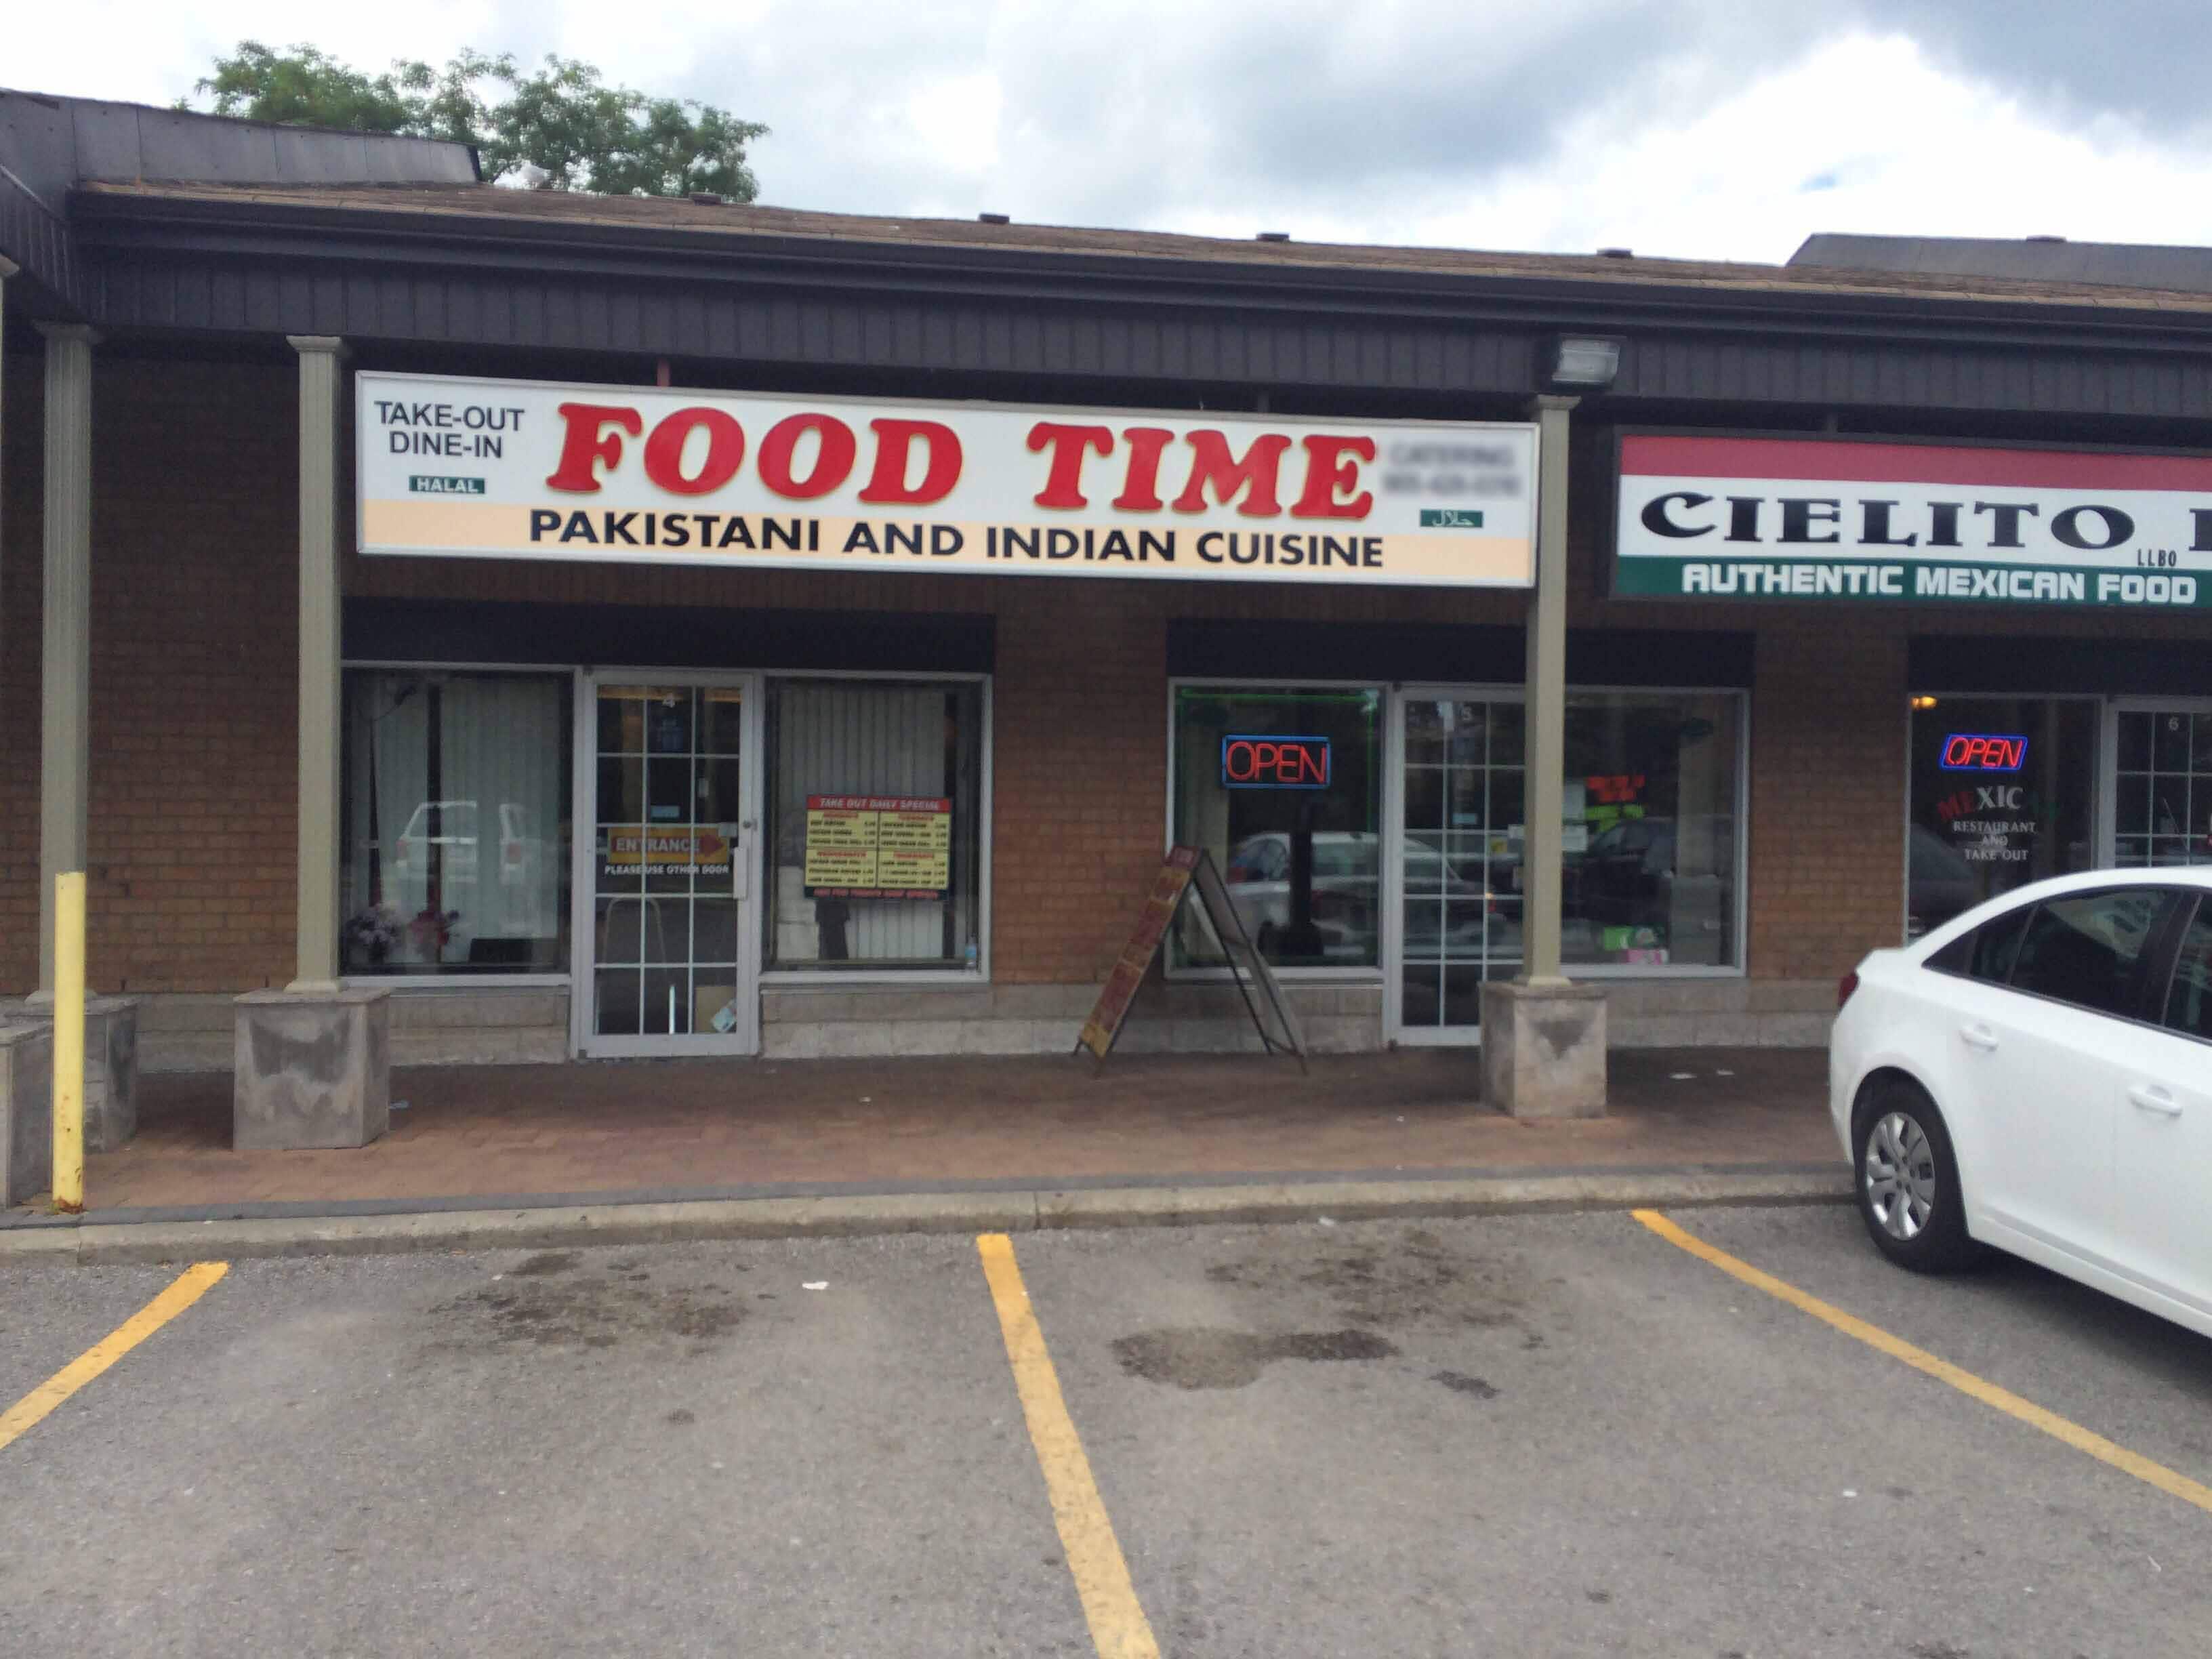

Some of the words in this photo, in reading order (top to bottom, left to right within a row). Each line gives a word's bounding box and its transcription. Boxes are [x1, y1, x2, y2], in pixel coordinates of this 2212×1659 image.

[373, 401, 526, 431] TAKE-OUT
[389, 430, 502, 459] DINE-IN
[544, 401, 963, 506] FOOD
[1025, 420, 1377, 521] TIME
[416, 476, 479, 493] HALAL
[1640, 490, 2136, 550] CIELITO
[529, 509, 819, 552] PAKISTANI
[842, 521, 964, 557] AND
[986, 527, 1175, 562] INDIAN
[1195, 531, 1383, 568] CUISINE
[2137, 548, 2177, 567] LLBO
[1681, 562, 1904, 594] AUTHENTIC
[1915, 567, 2085, 600] MEXICAN
[2097, 573, 2197, 605] FOOD
[1226, 741, 1327, 783] OPEN
[1946, 736, 2024, 767] OPEN
[846, 798, 867, 808] OUT
[1952, 820, 2037, 833] RESTAURANT
[1980, 834, 2009, 846] AND
[1965, 848, 1998, 861] TAKE
[2001, 849, 2030, 861] OUT
[604, 864, 643, 875] PLEASE
